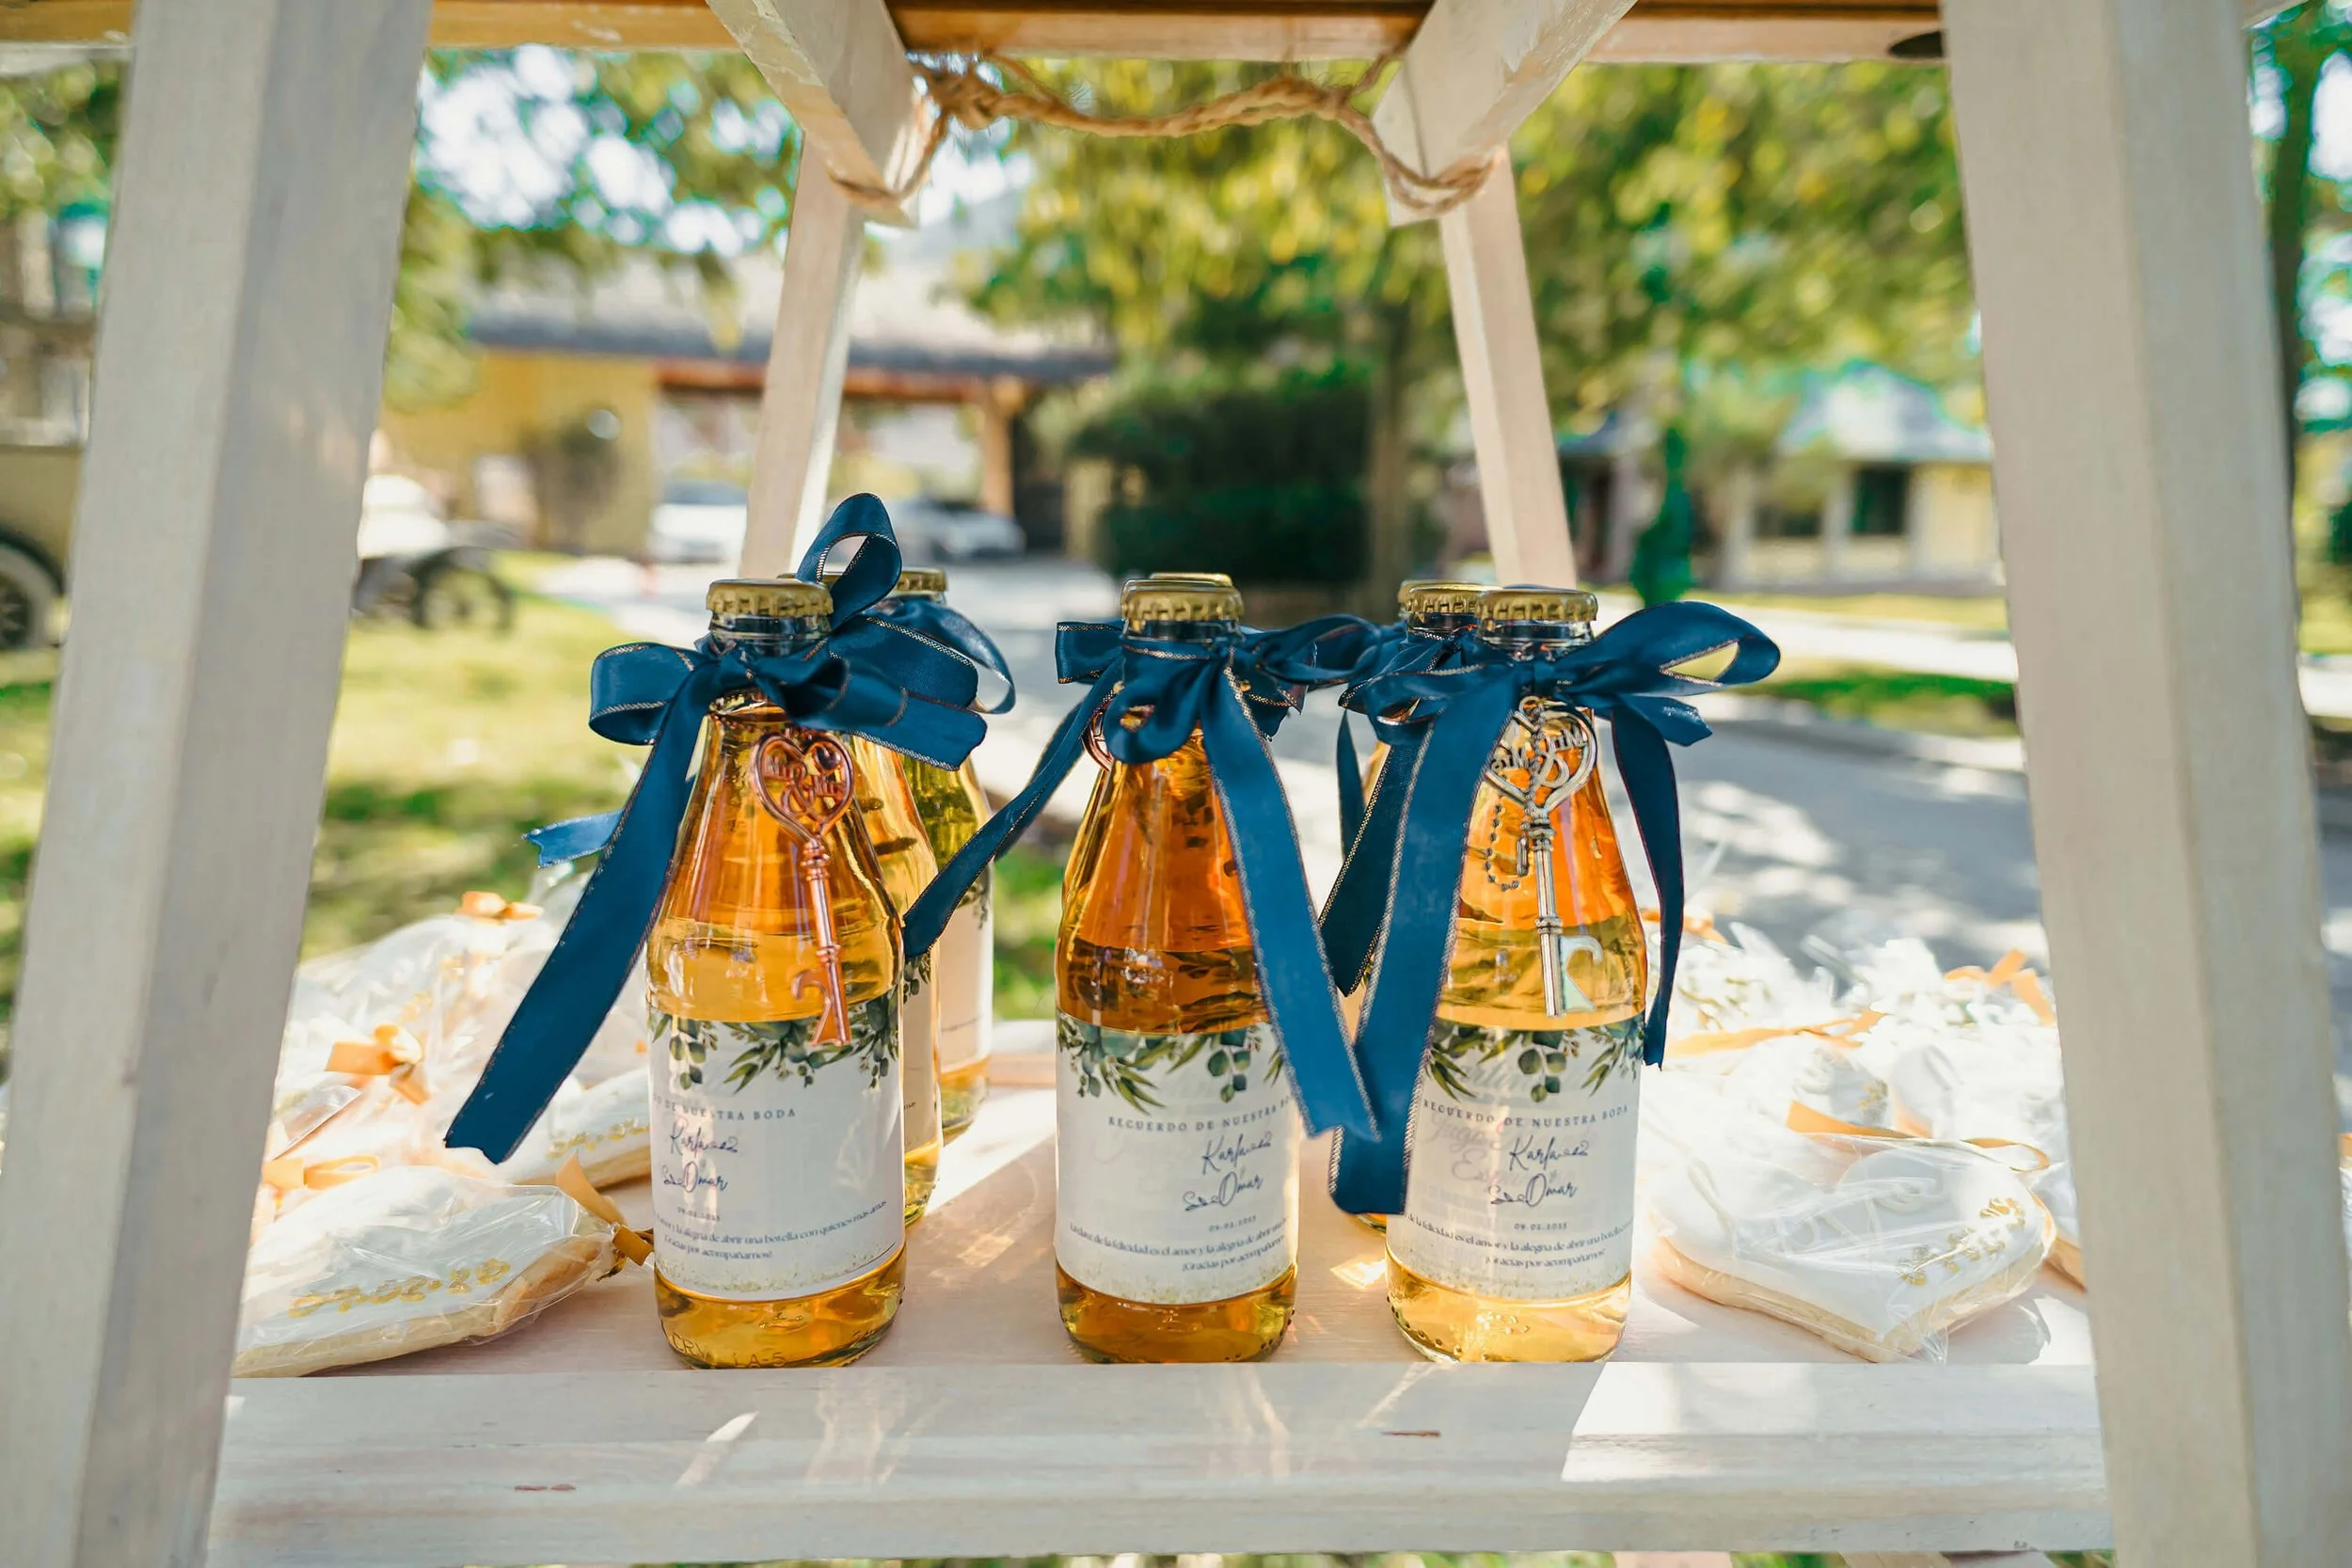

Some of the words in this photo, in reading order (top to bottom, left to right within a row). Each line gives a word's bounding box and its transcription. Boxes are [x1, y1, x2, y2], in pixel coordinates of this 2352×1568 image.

[753, 1108, 797, 1121] BODA
[1108, 1116, 1188, 1132] RECUERDO
[1195, 1120, 1215, 1132] DE
[1222, 1104, 1277, 1128] NUESTRA
[1423, 1099, 1495, 1123] RECUERDO
[1503, 1117, 1523, 1127] DE
[1532, 1115, 1597, 1128] NUESTRA
[1601, 1103, 1629, 1120] BODA
[662, 1161, 728, 1193] Omar
[1183, 1171, 1263, 1212] Omar
[1487, 1173, 1577, 1208] Omar
[764, 1230, 799, 1243] botella
[800, 1227, 818, 1240] con
[1112, 1241, 1149, 1255] felicidad
[1172, 1247, 1197, 1257] amor
[1422, 1220, 1454, 1240] felicidad
[1466, 1235, 1474, 1244] el
[1510, 1241, 1518, 1251] la
